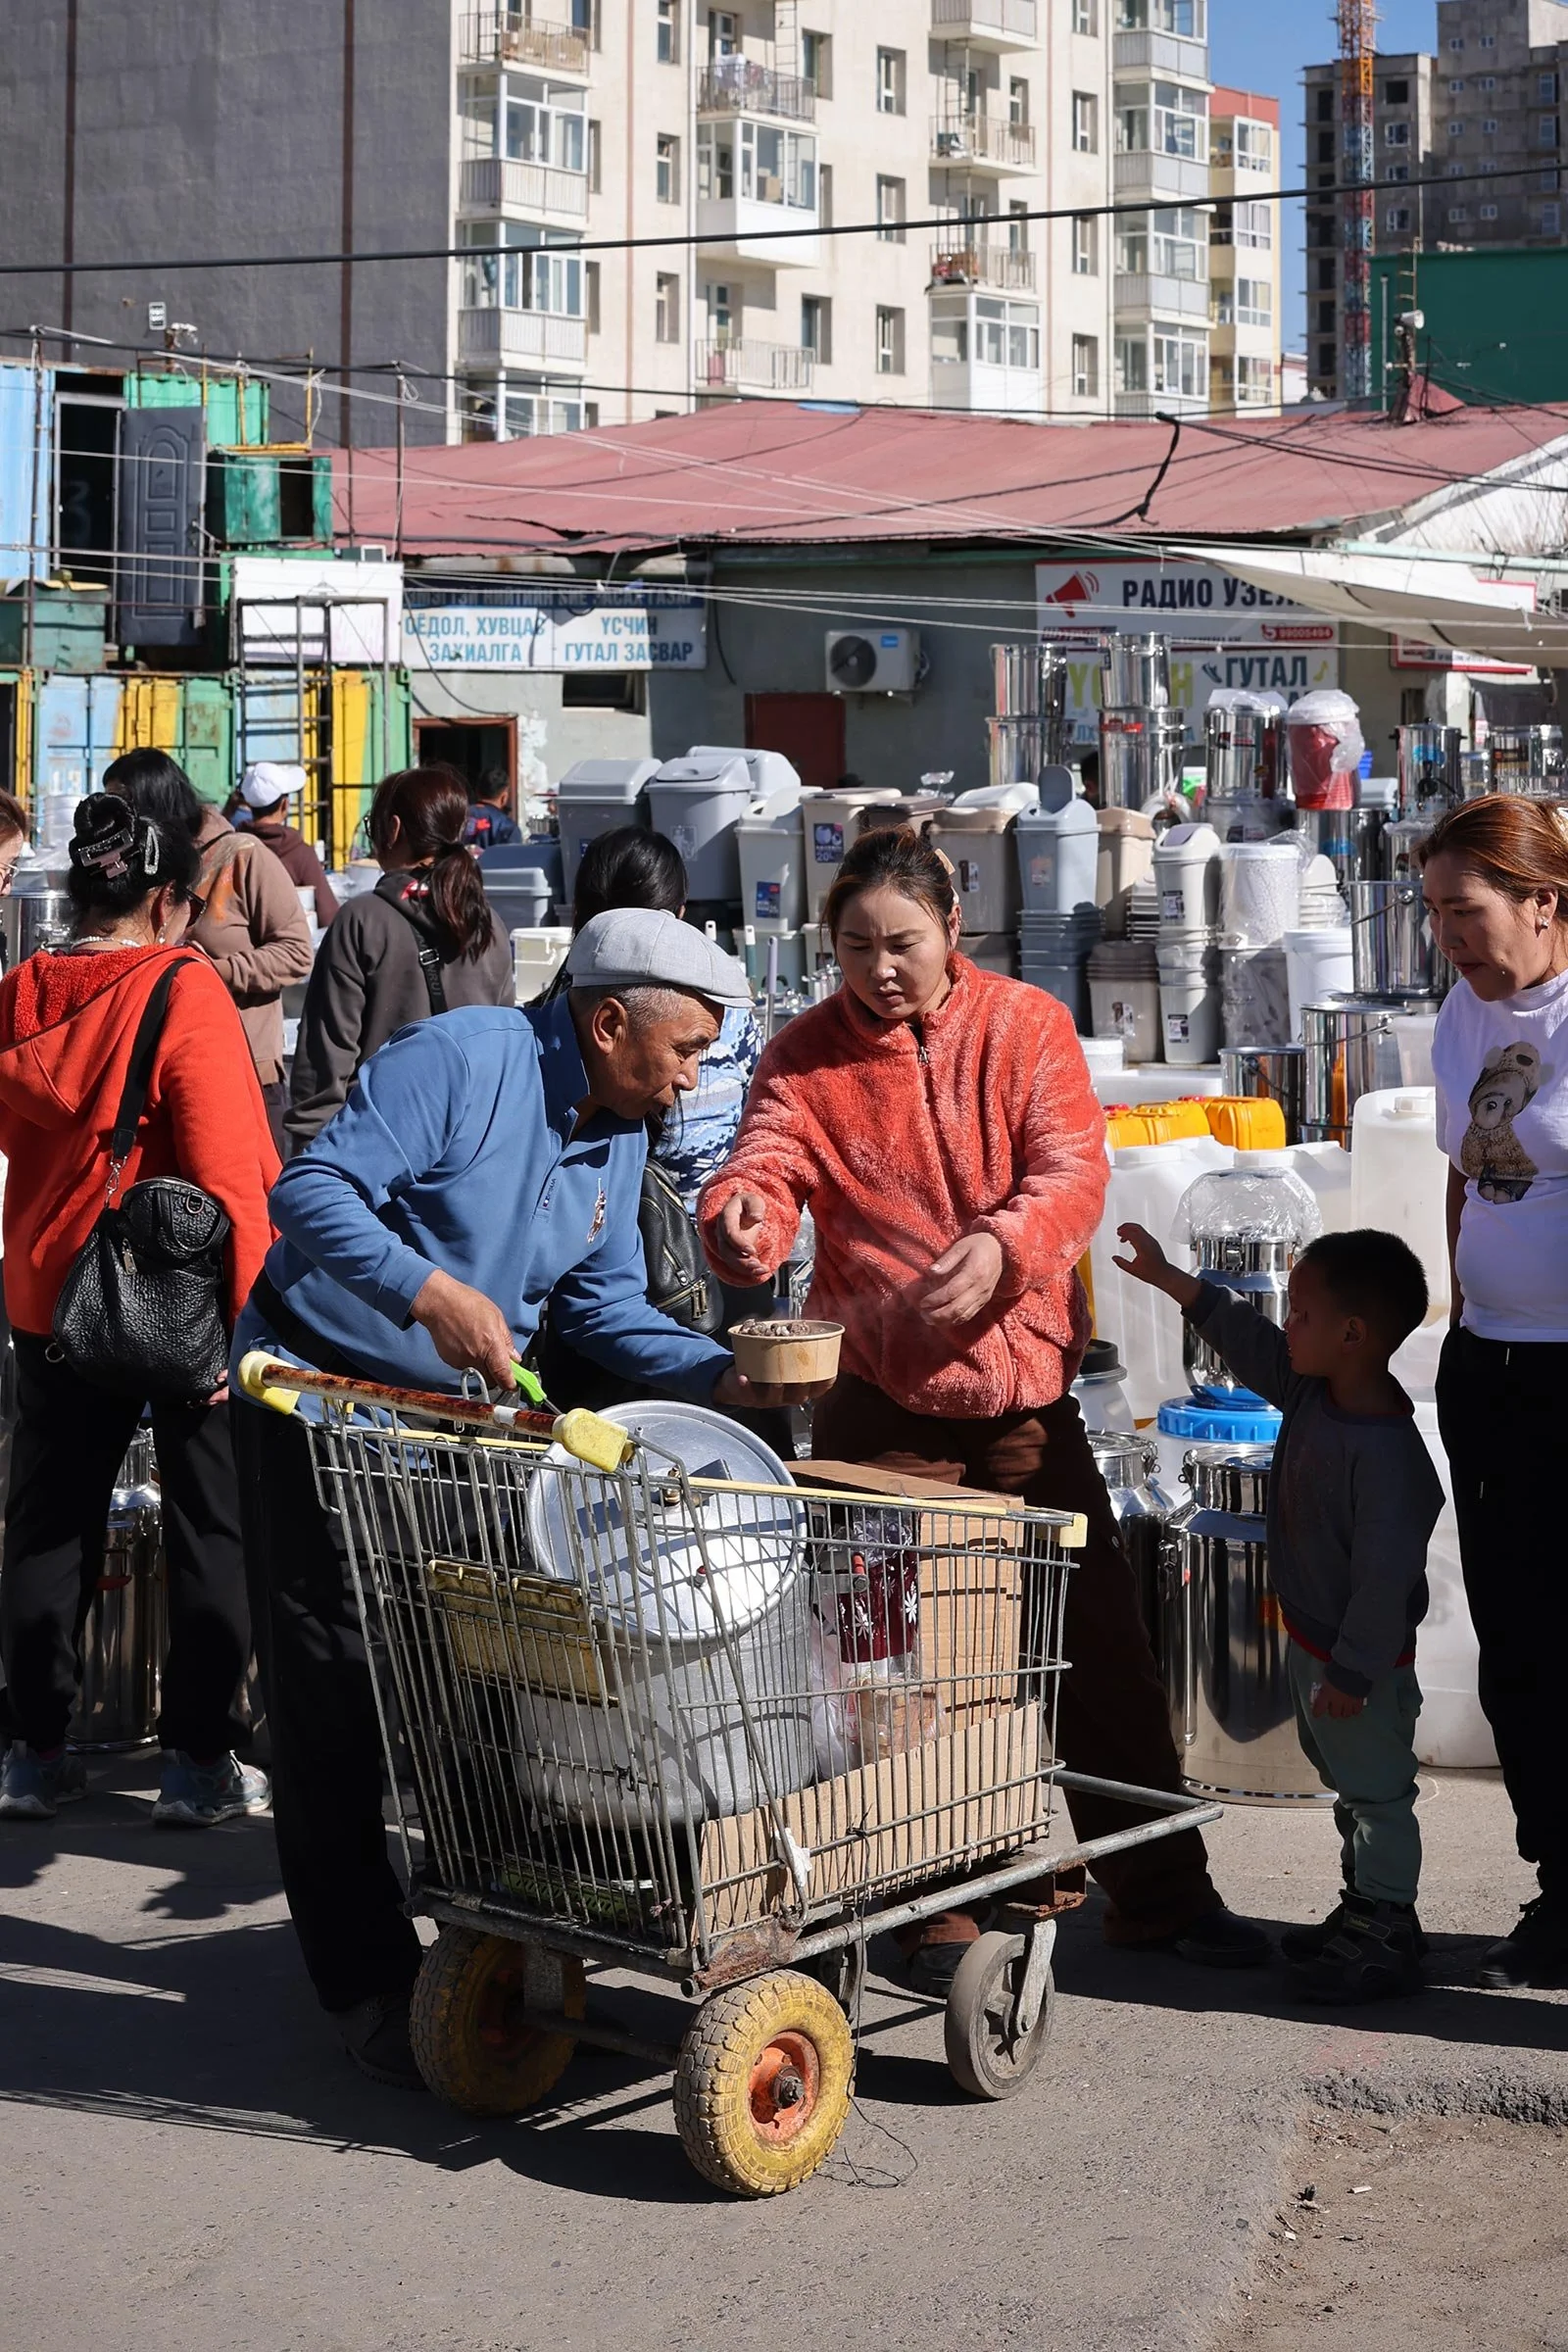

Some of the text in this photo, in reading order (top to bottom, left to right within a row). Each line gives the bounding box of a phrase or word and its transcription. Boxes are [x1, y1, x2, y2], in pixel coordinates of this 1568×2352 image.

[1123, 578, 1212, 609] РАДИО
[429, 643, 522, 662] ЗАХИАЛГА
[564, 642, 693, 662] ГУТАЛ ЗАСВАР
[1226, 656, 1307, 688] ГУТАЛ
